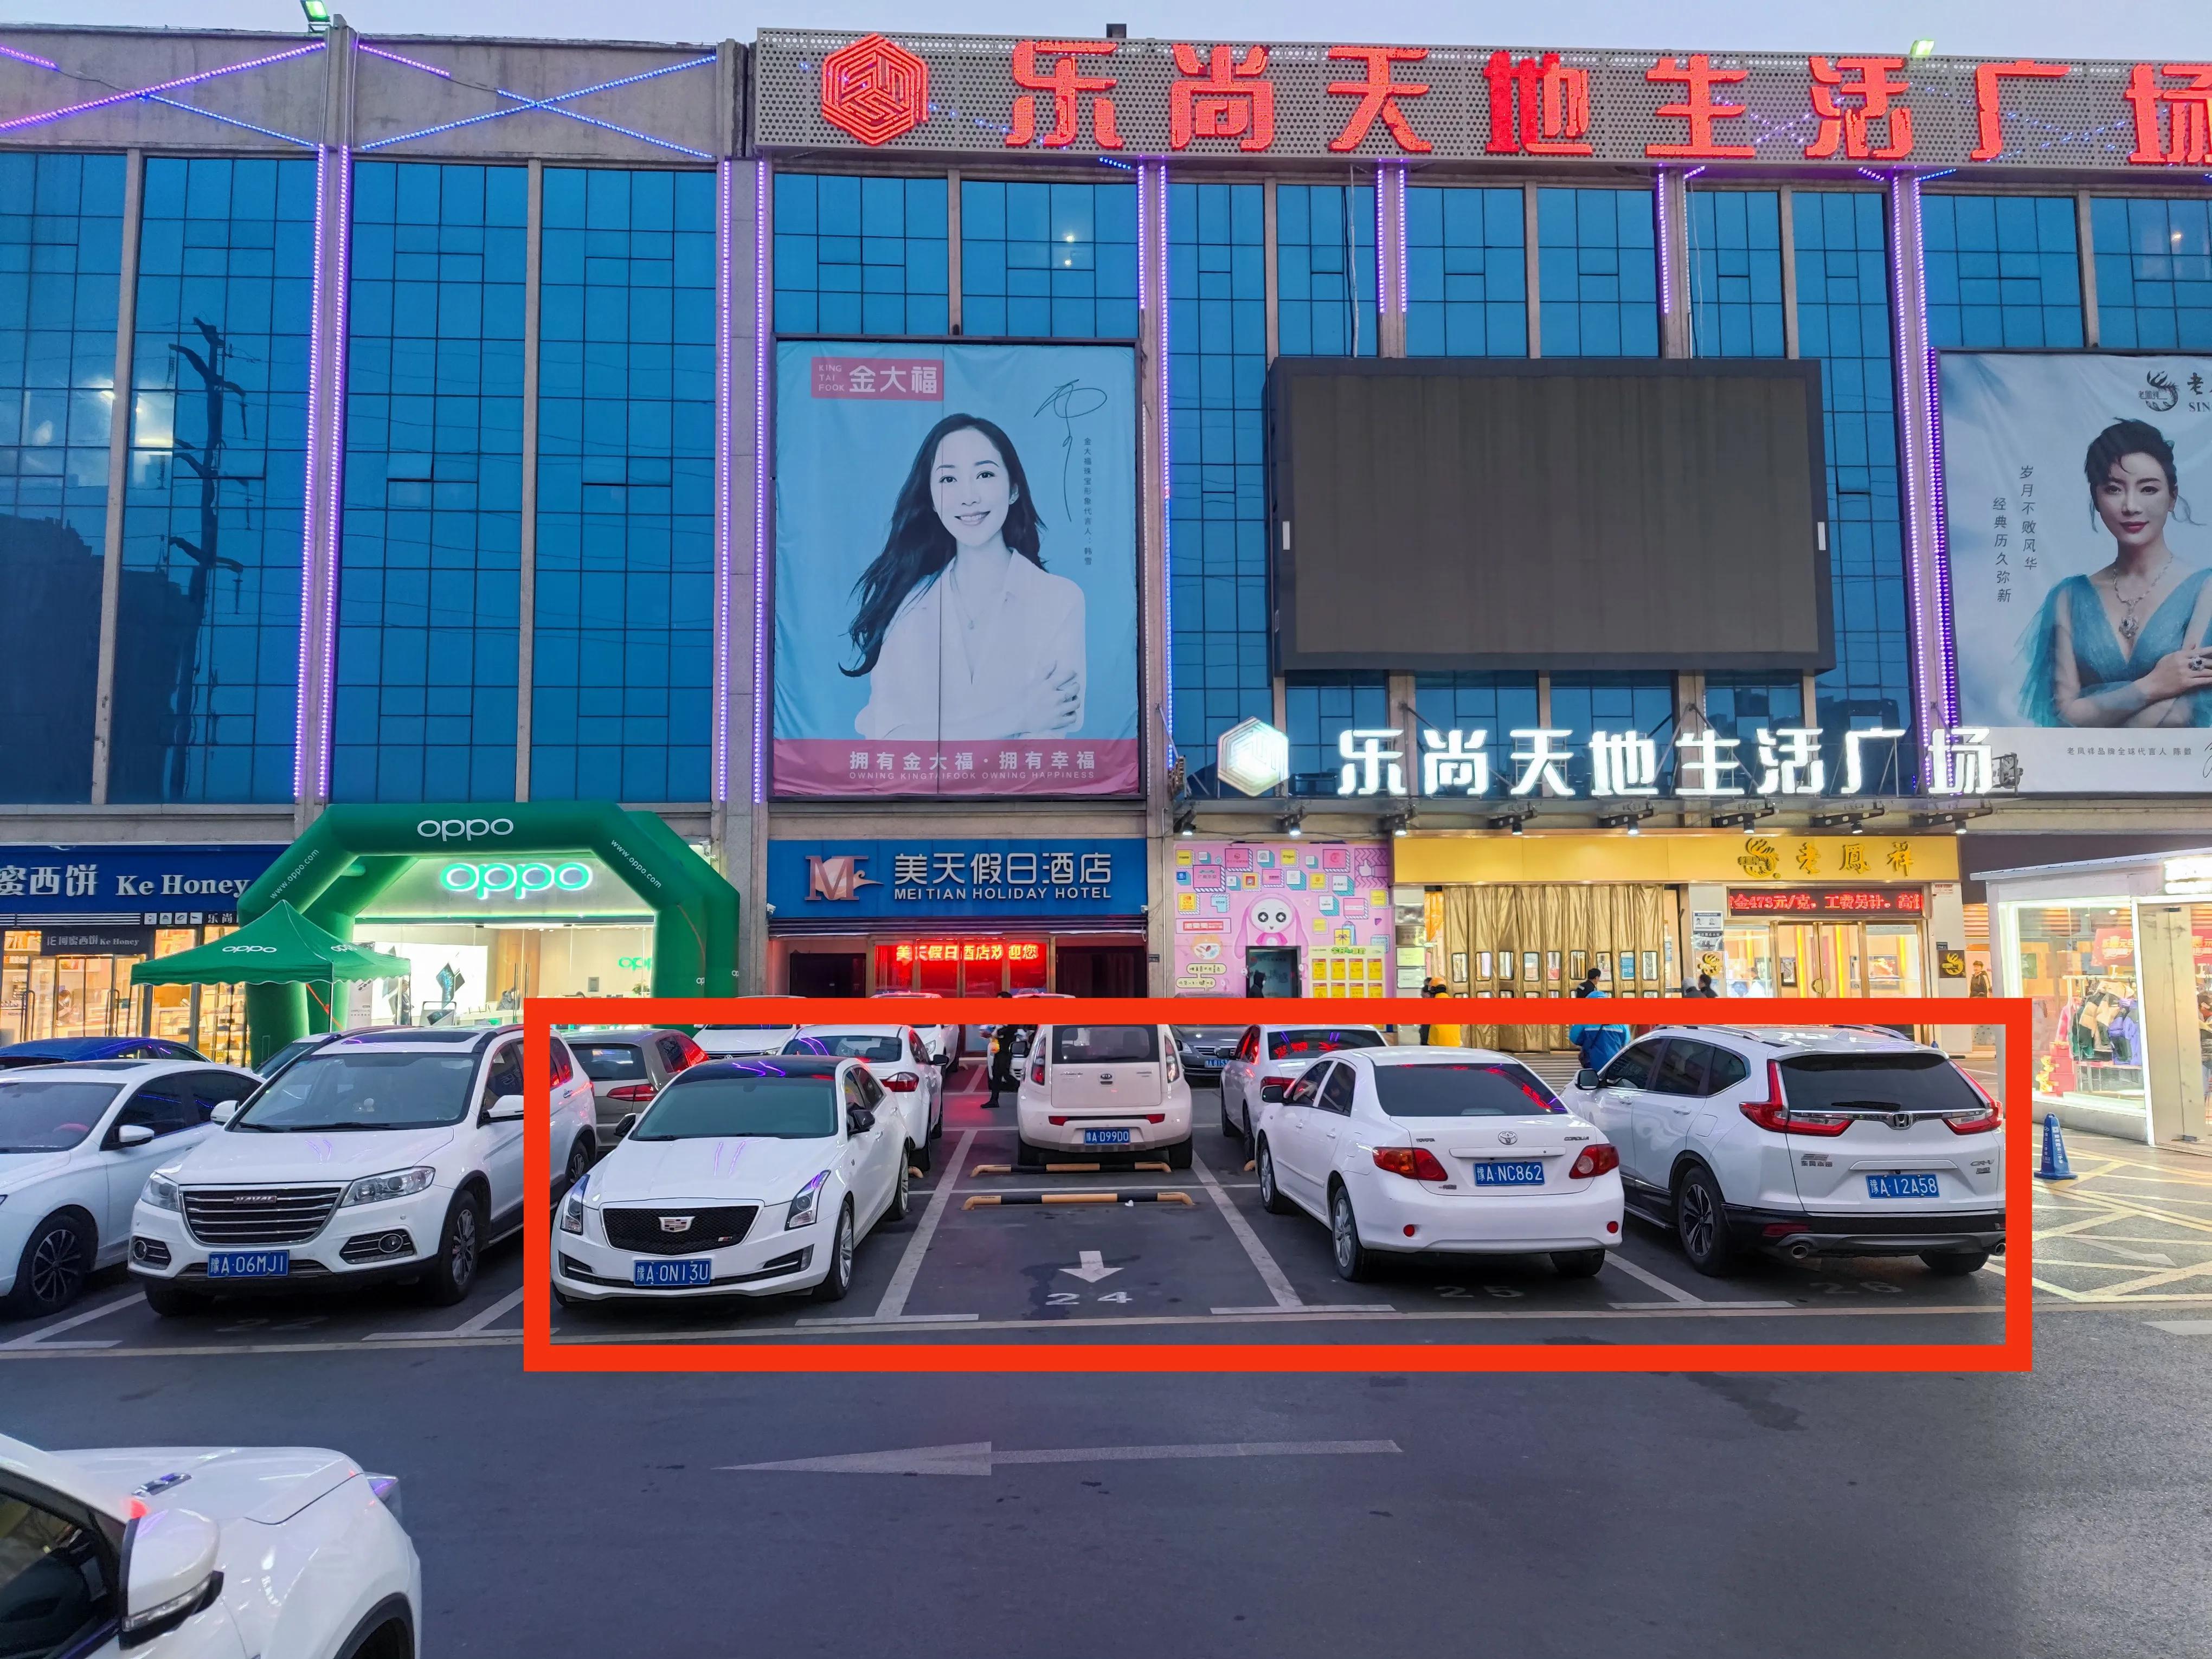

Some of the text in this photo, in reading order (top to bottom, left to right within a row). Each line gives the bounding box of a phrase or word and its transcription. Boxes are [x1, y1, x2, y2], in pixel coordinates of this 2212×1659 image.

[1005, 40, 2212, 164] 乐尚天地生活广场
[849, 365, 937, 394] 金大福
[2187, 372, 2212, 395] 老
[2188, 402, 2212, 412] SIN
[2020, 465, 2037, 570] 岁月不败风华
[1992, 497, 2011, 603] 经典历久弥新
[850, 751, 1096, 771] 拥有金大福·拥有幸福
[1337, 728, 1995, 796] 乐尚天地生活广场
[417, 819, 513, 841] oppo
[269, 848, 319, 899] www.oppo.com
[610, 839, 661, 889] www.oppo.com
[894, 853, 1111, 885] 美天假日酒店
[0, 864, 98, 897] 蜜西饼
[115, 874, 250, 898] Ke Honey
[441, 862, 592, 899] oppo
[894, 887, 1111, 899] MEI TIAN HOLIDAY HOTEL
[207, 912, 238, 924] 乐尚
